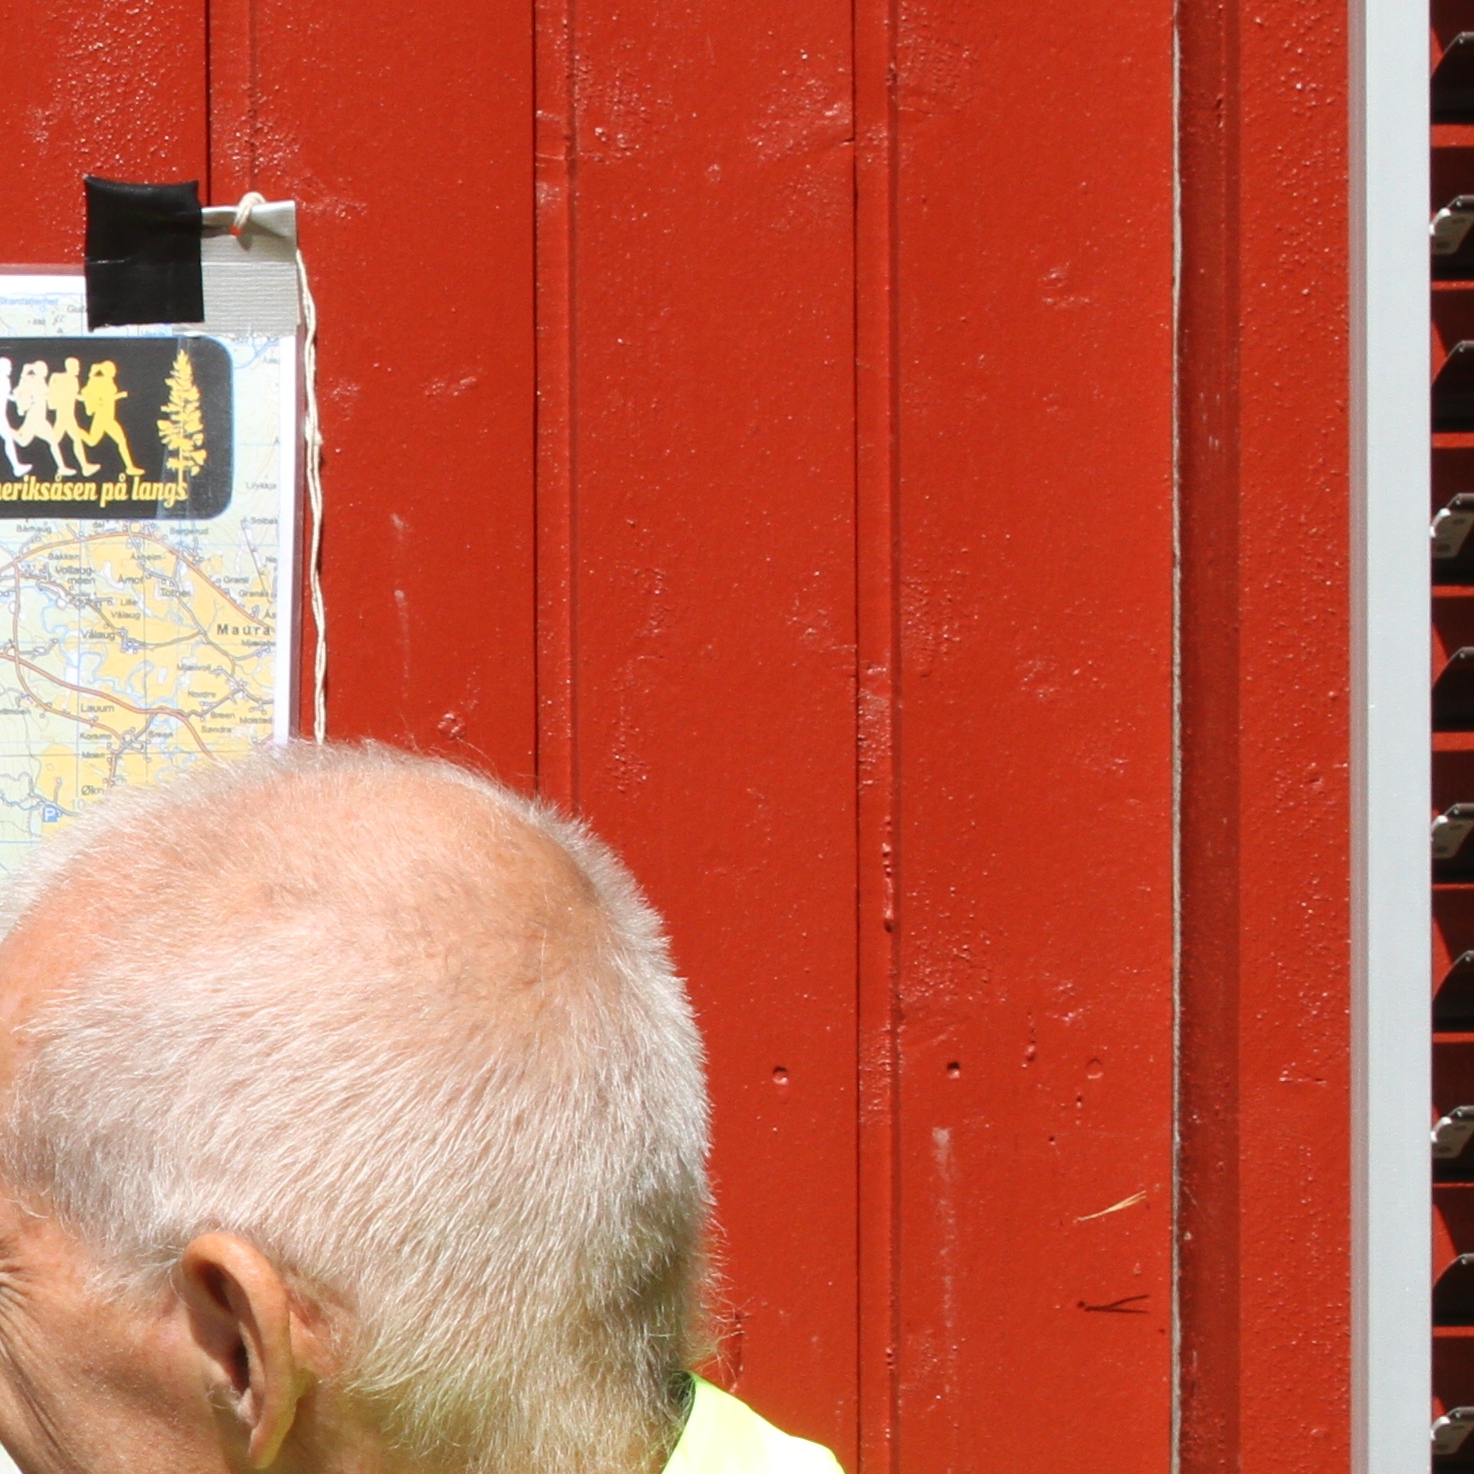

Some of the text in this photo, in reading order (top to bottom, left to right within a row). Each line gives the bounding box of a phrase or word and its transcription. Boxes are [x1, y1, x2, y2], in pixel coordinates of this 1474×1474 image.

[100, 473, 128, 507] på
[132, 475, 188, 507] langs
[217, 624, 271, 636] Maura
